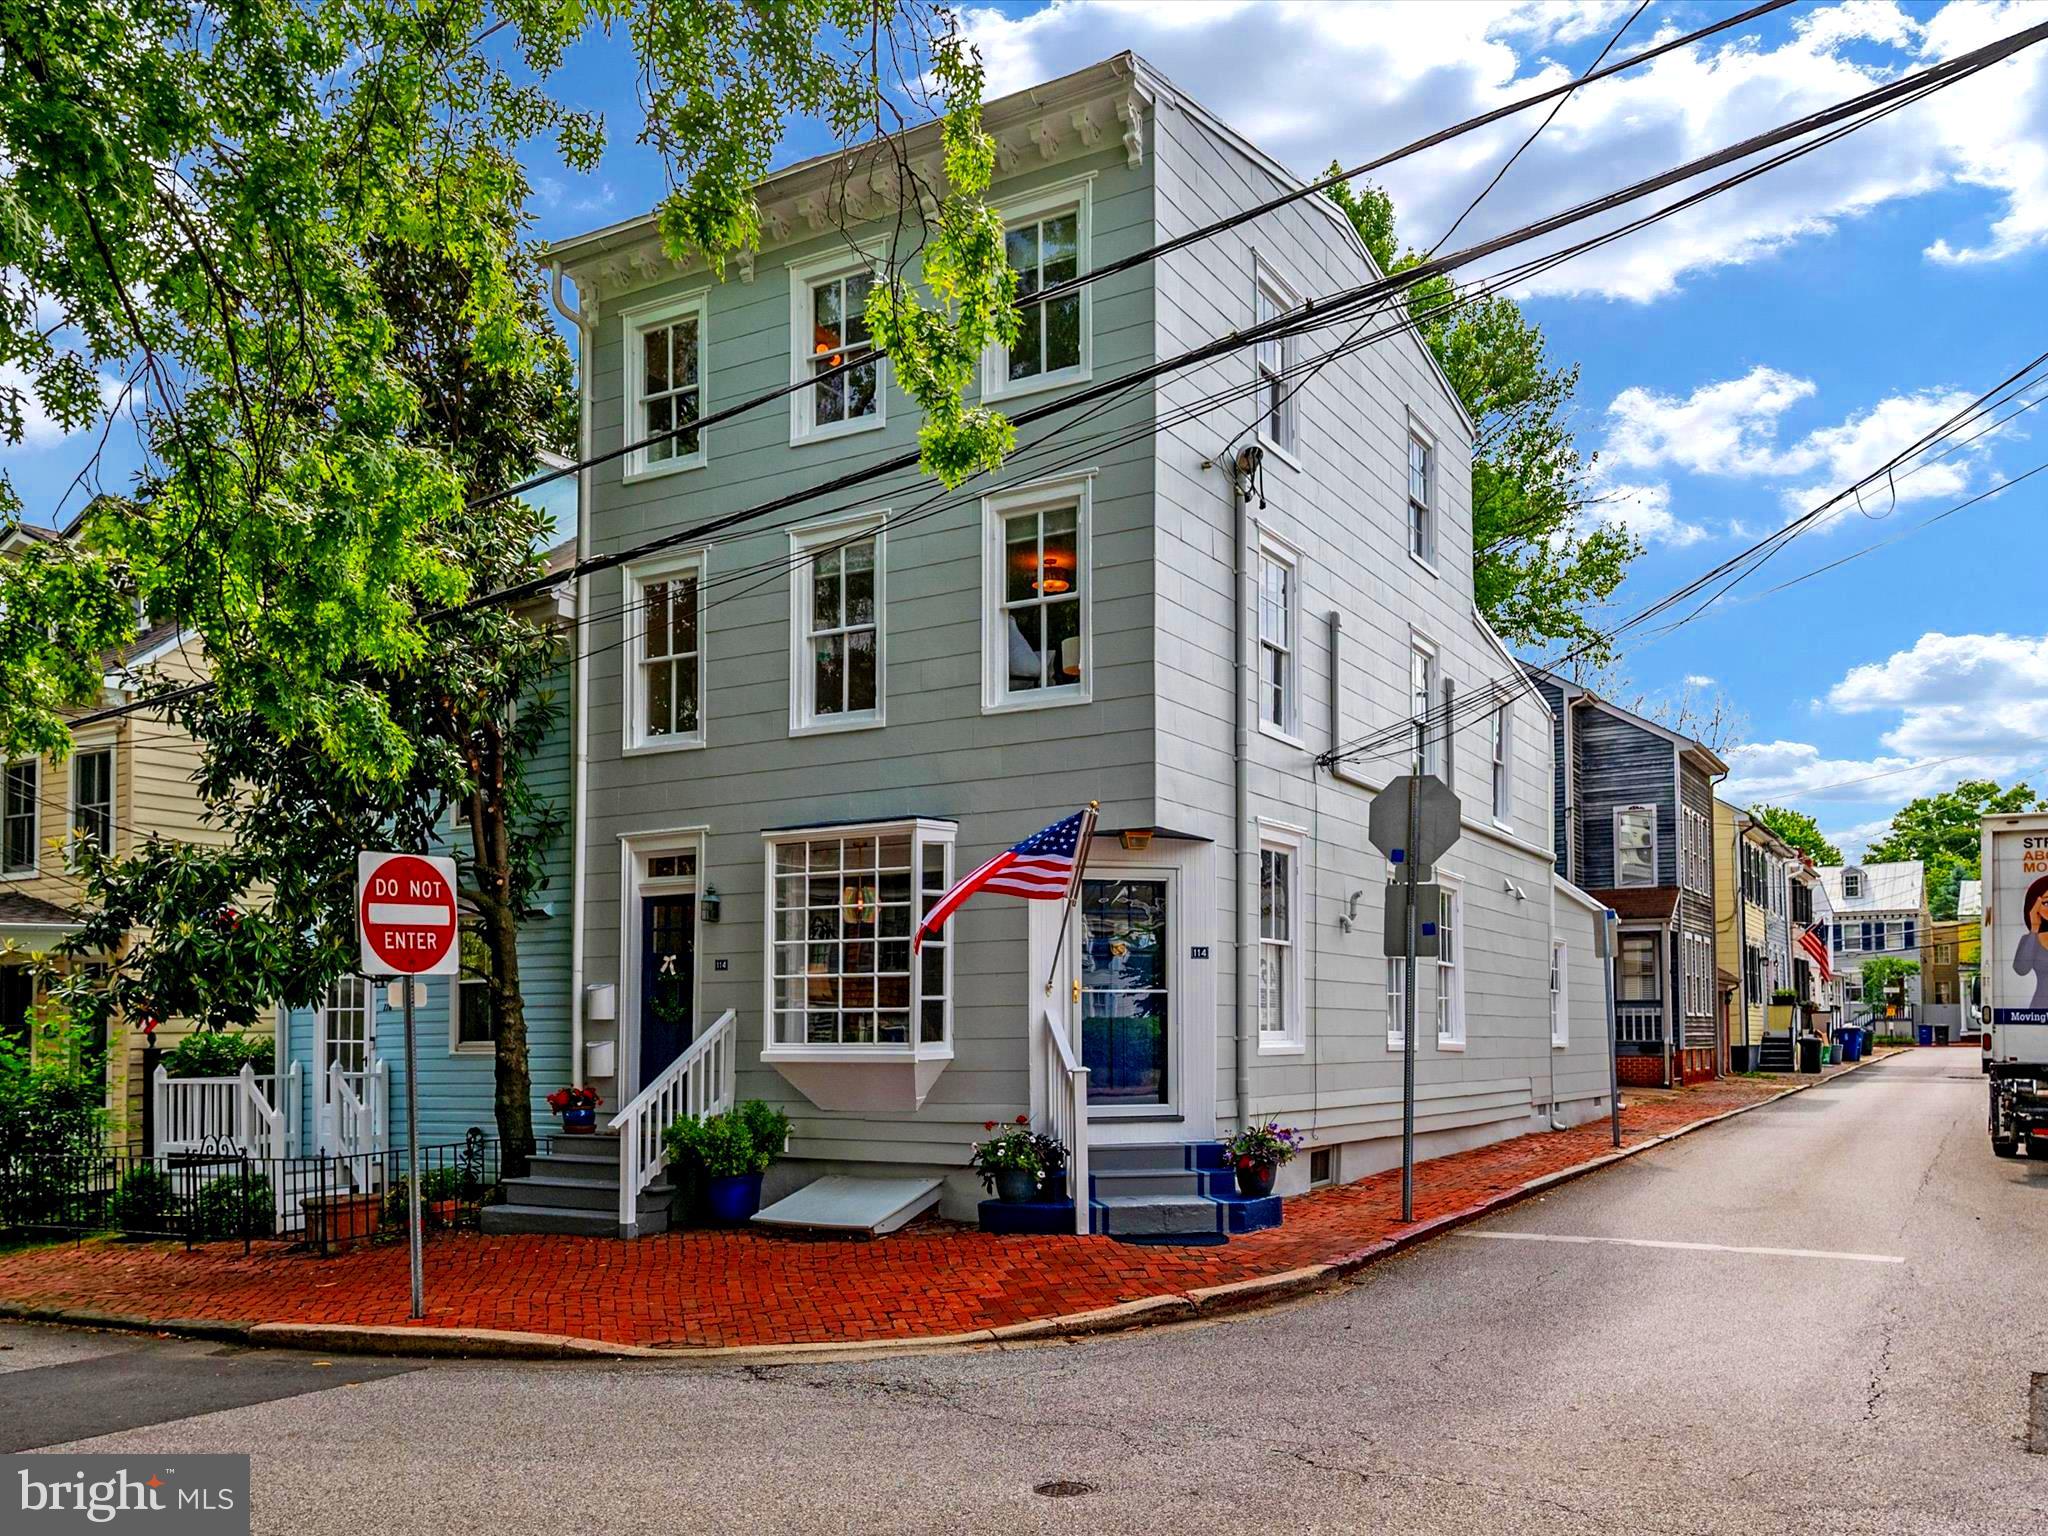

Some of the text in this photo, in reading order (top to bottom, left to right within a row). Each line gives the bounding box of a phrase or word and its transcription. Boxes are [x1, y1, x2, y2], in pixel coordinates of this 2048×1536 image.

[2023, 850, 2048, 861] AB
[375, 878, 442, 899] DO NOT
[384, 931, 437, 950] ENTER
[1192, 948, 1208, 958] 114
[716, 960, 727, 969] 114
[2010, 1011, 2048, 1024] Moving
